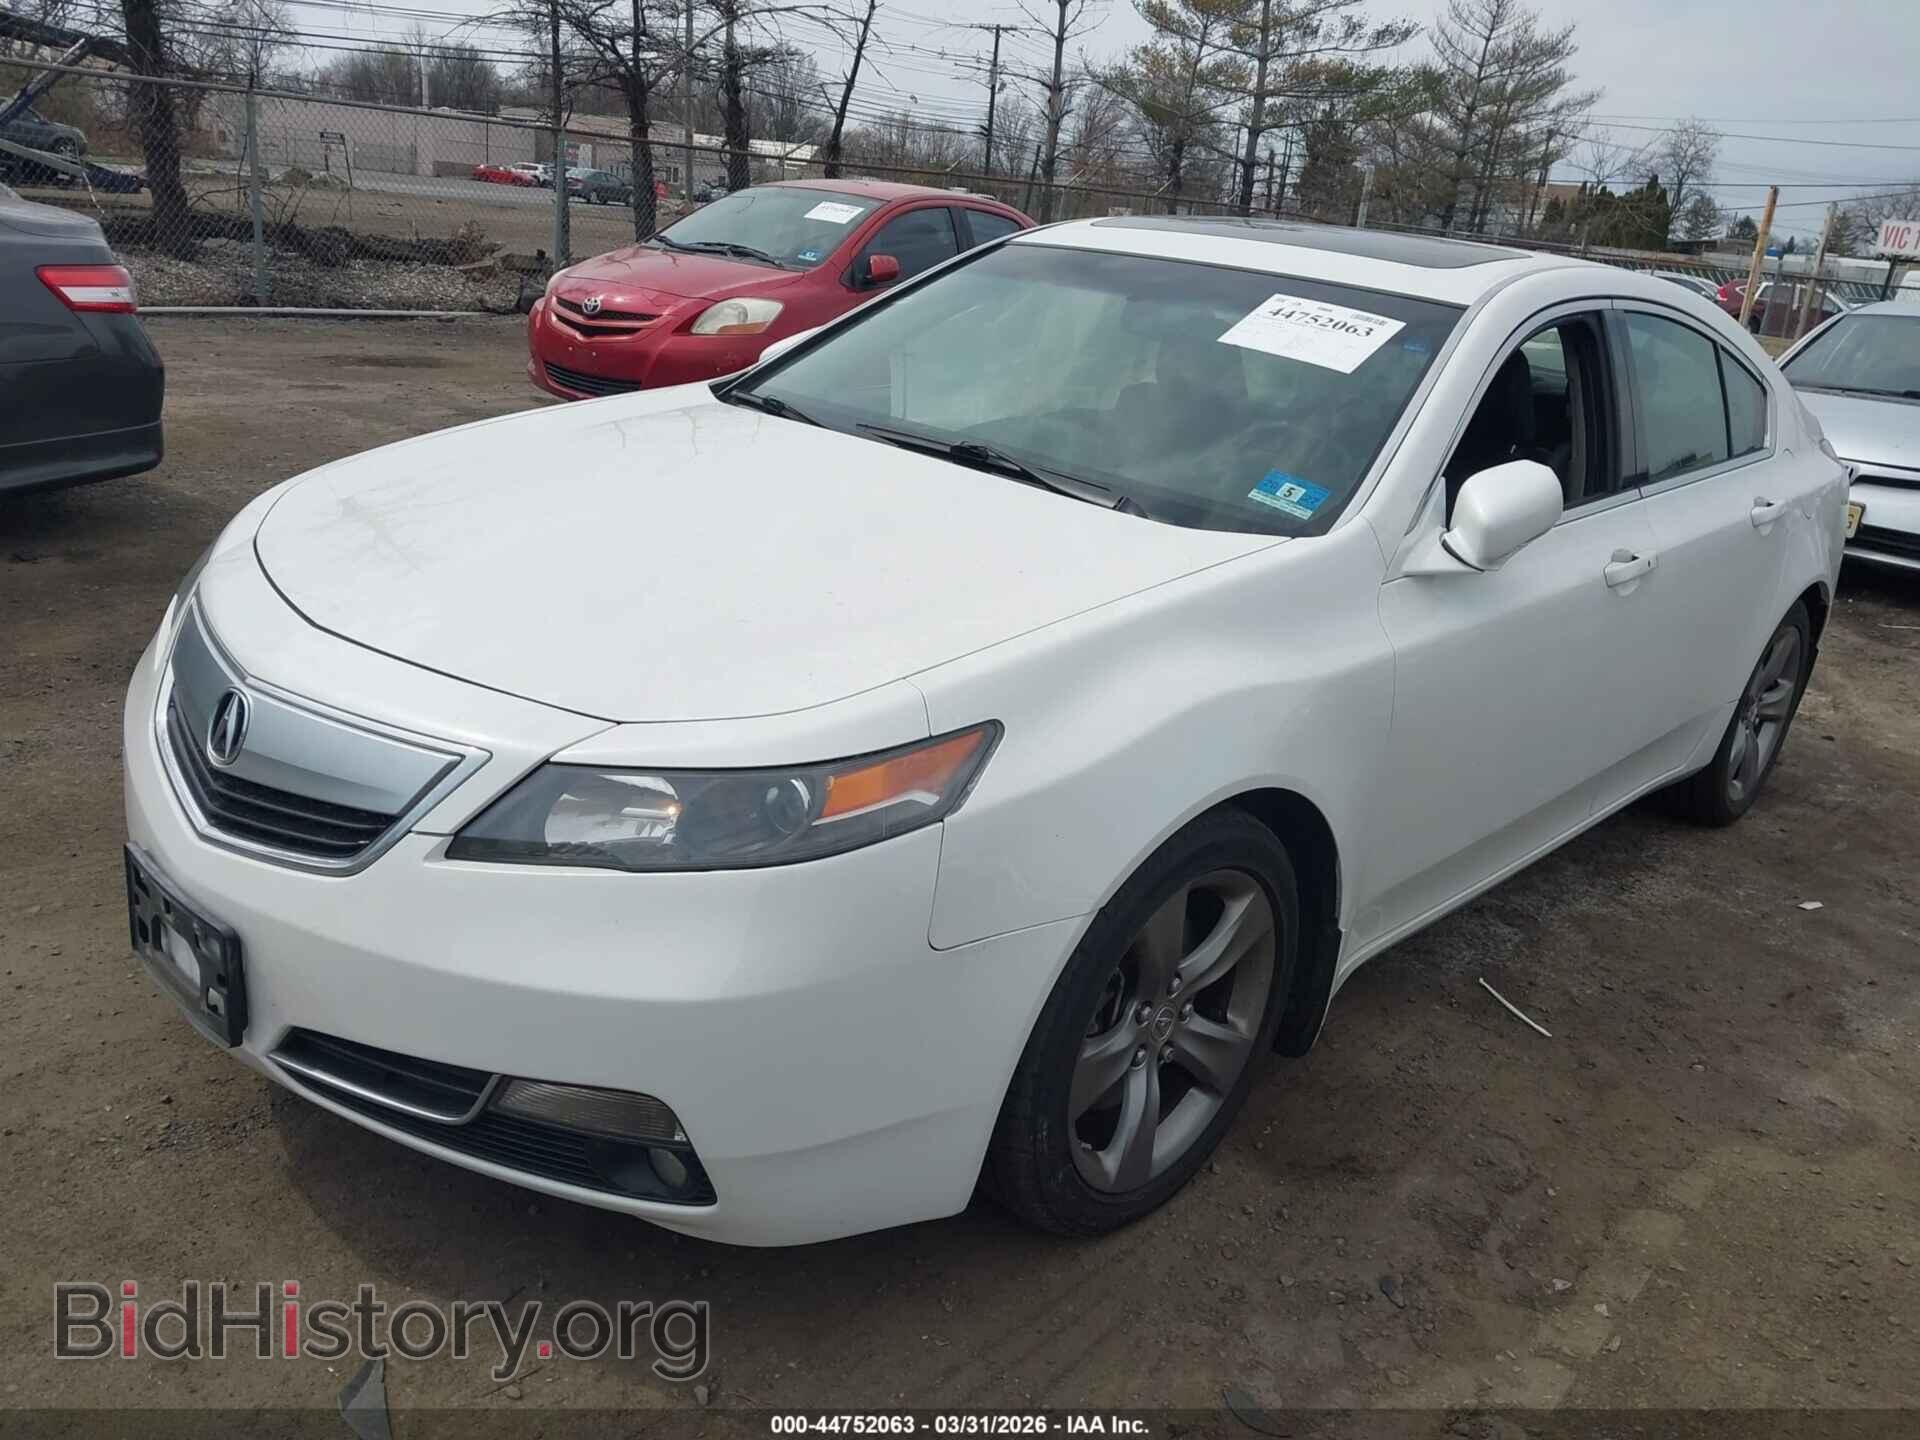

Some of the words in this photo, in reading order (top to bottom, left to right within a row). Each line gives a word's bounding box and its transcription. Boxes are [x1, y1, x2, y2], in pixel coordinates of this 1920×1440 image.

[1883, 225, 1912, 250] VIC
[1268, 306, 1375, 338] 44752063
[1283, 487, 1296, 498] 5
